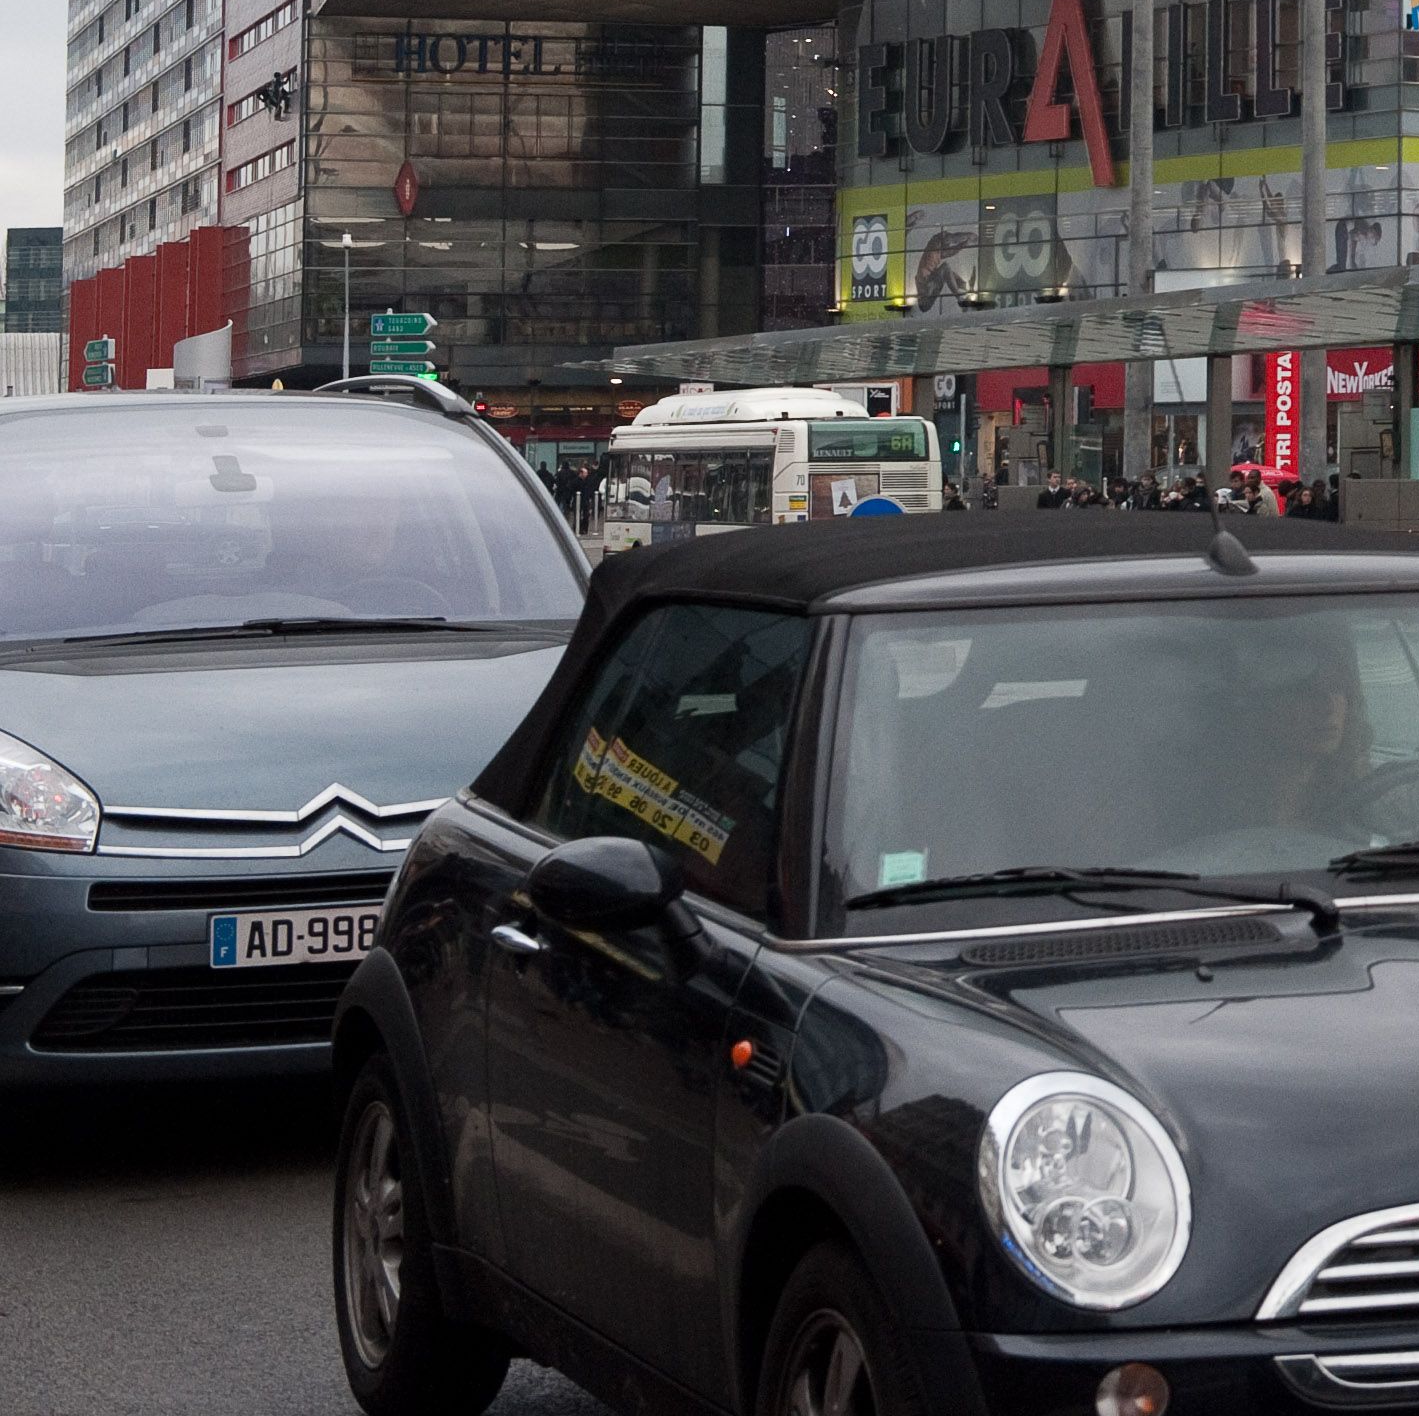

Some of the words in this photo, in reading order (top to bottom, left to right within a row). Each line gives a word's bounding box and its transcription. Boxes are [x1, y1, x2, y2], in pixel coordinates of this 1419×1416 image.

[395, 34, 562, 75] HOTEL
[852, 221, 888, 276] GO
[852, 284, 887, 300] SPORT
[934, 374, 956, 398] GO
[1276, 350, 1293, 426] POSTA
[1276, 433, 1292, 470] TRI
[246, 914, 379, 958] AD-998
